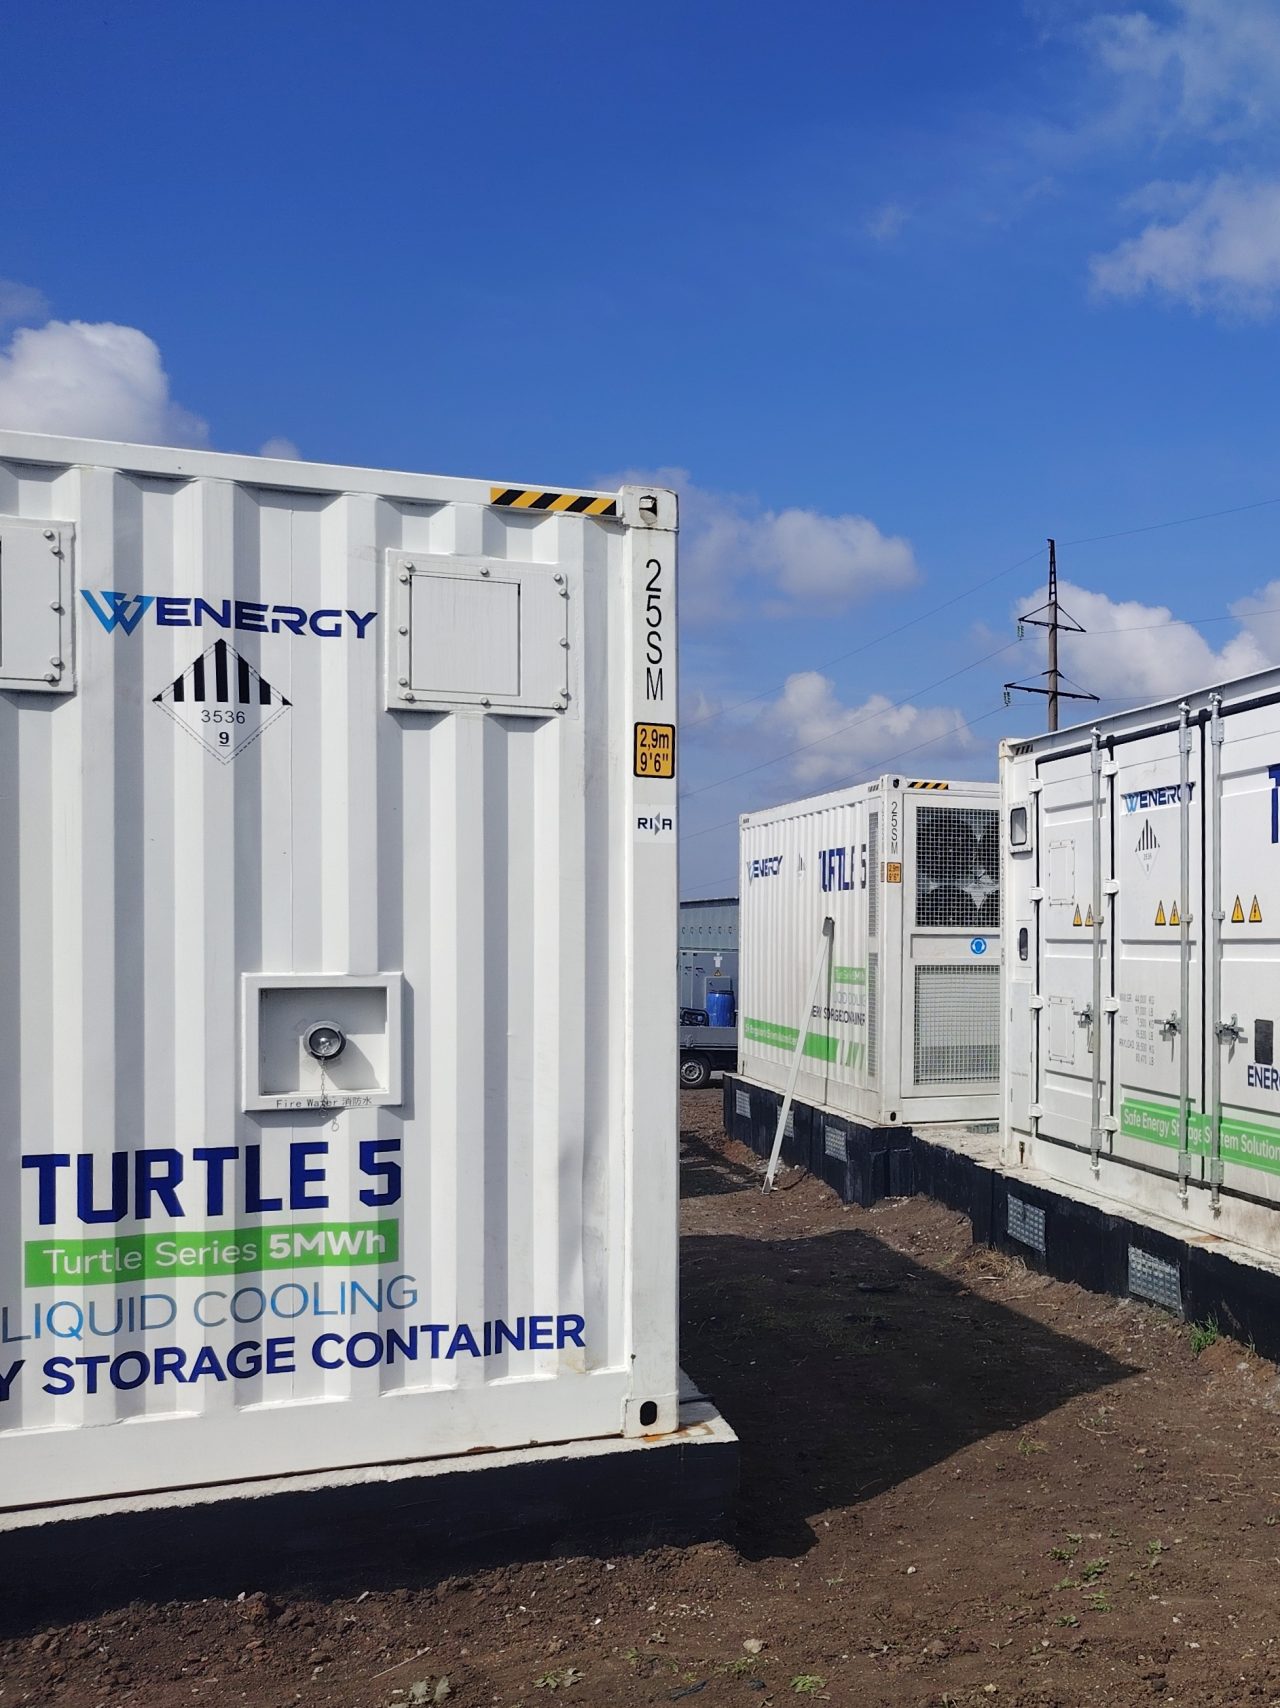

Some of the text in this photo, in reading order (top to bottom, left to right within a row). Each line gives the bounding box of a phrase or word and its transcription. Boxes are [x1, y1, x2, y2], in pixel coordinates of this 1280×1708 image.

[80, 589, 378, 639] WENERGY
[645, 559, 664, 701] 25SM
[200, 709, 246, 724] 3536
[218, 731, 230, 746] 9
[276, 1099, 302, 1108] Fire
[1124, 1109, 1141, 1128] Safe
[1142, 1112, 1170, 1137] Energy
[21, 1138, 402, 1225] TURTLE 5
[42, 1229, 386, 1275] Turtle Series 5MWh
[2, 1274, 419, 1344] LIQUID COOLING
[42, 1336, 296, 1396] STORAGE
[311, 1313, 586, 1370] CONTAINER
